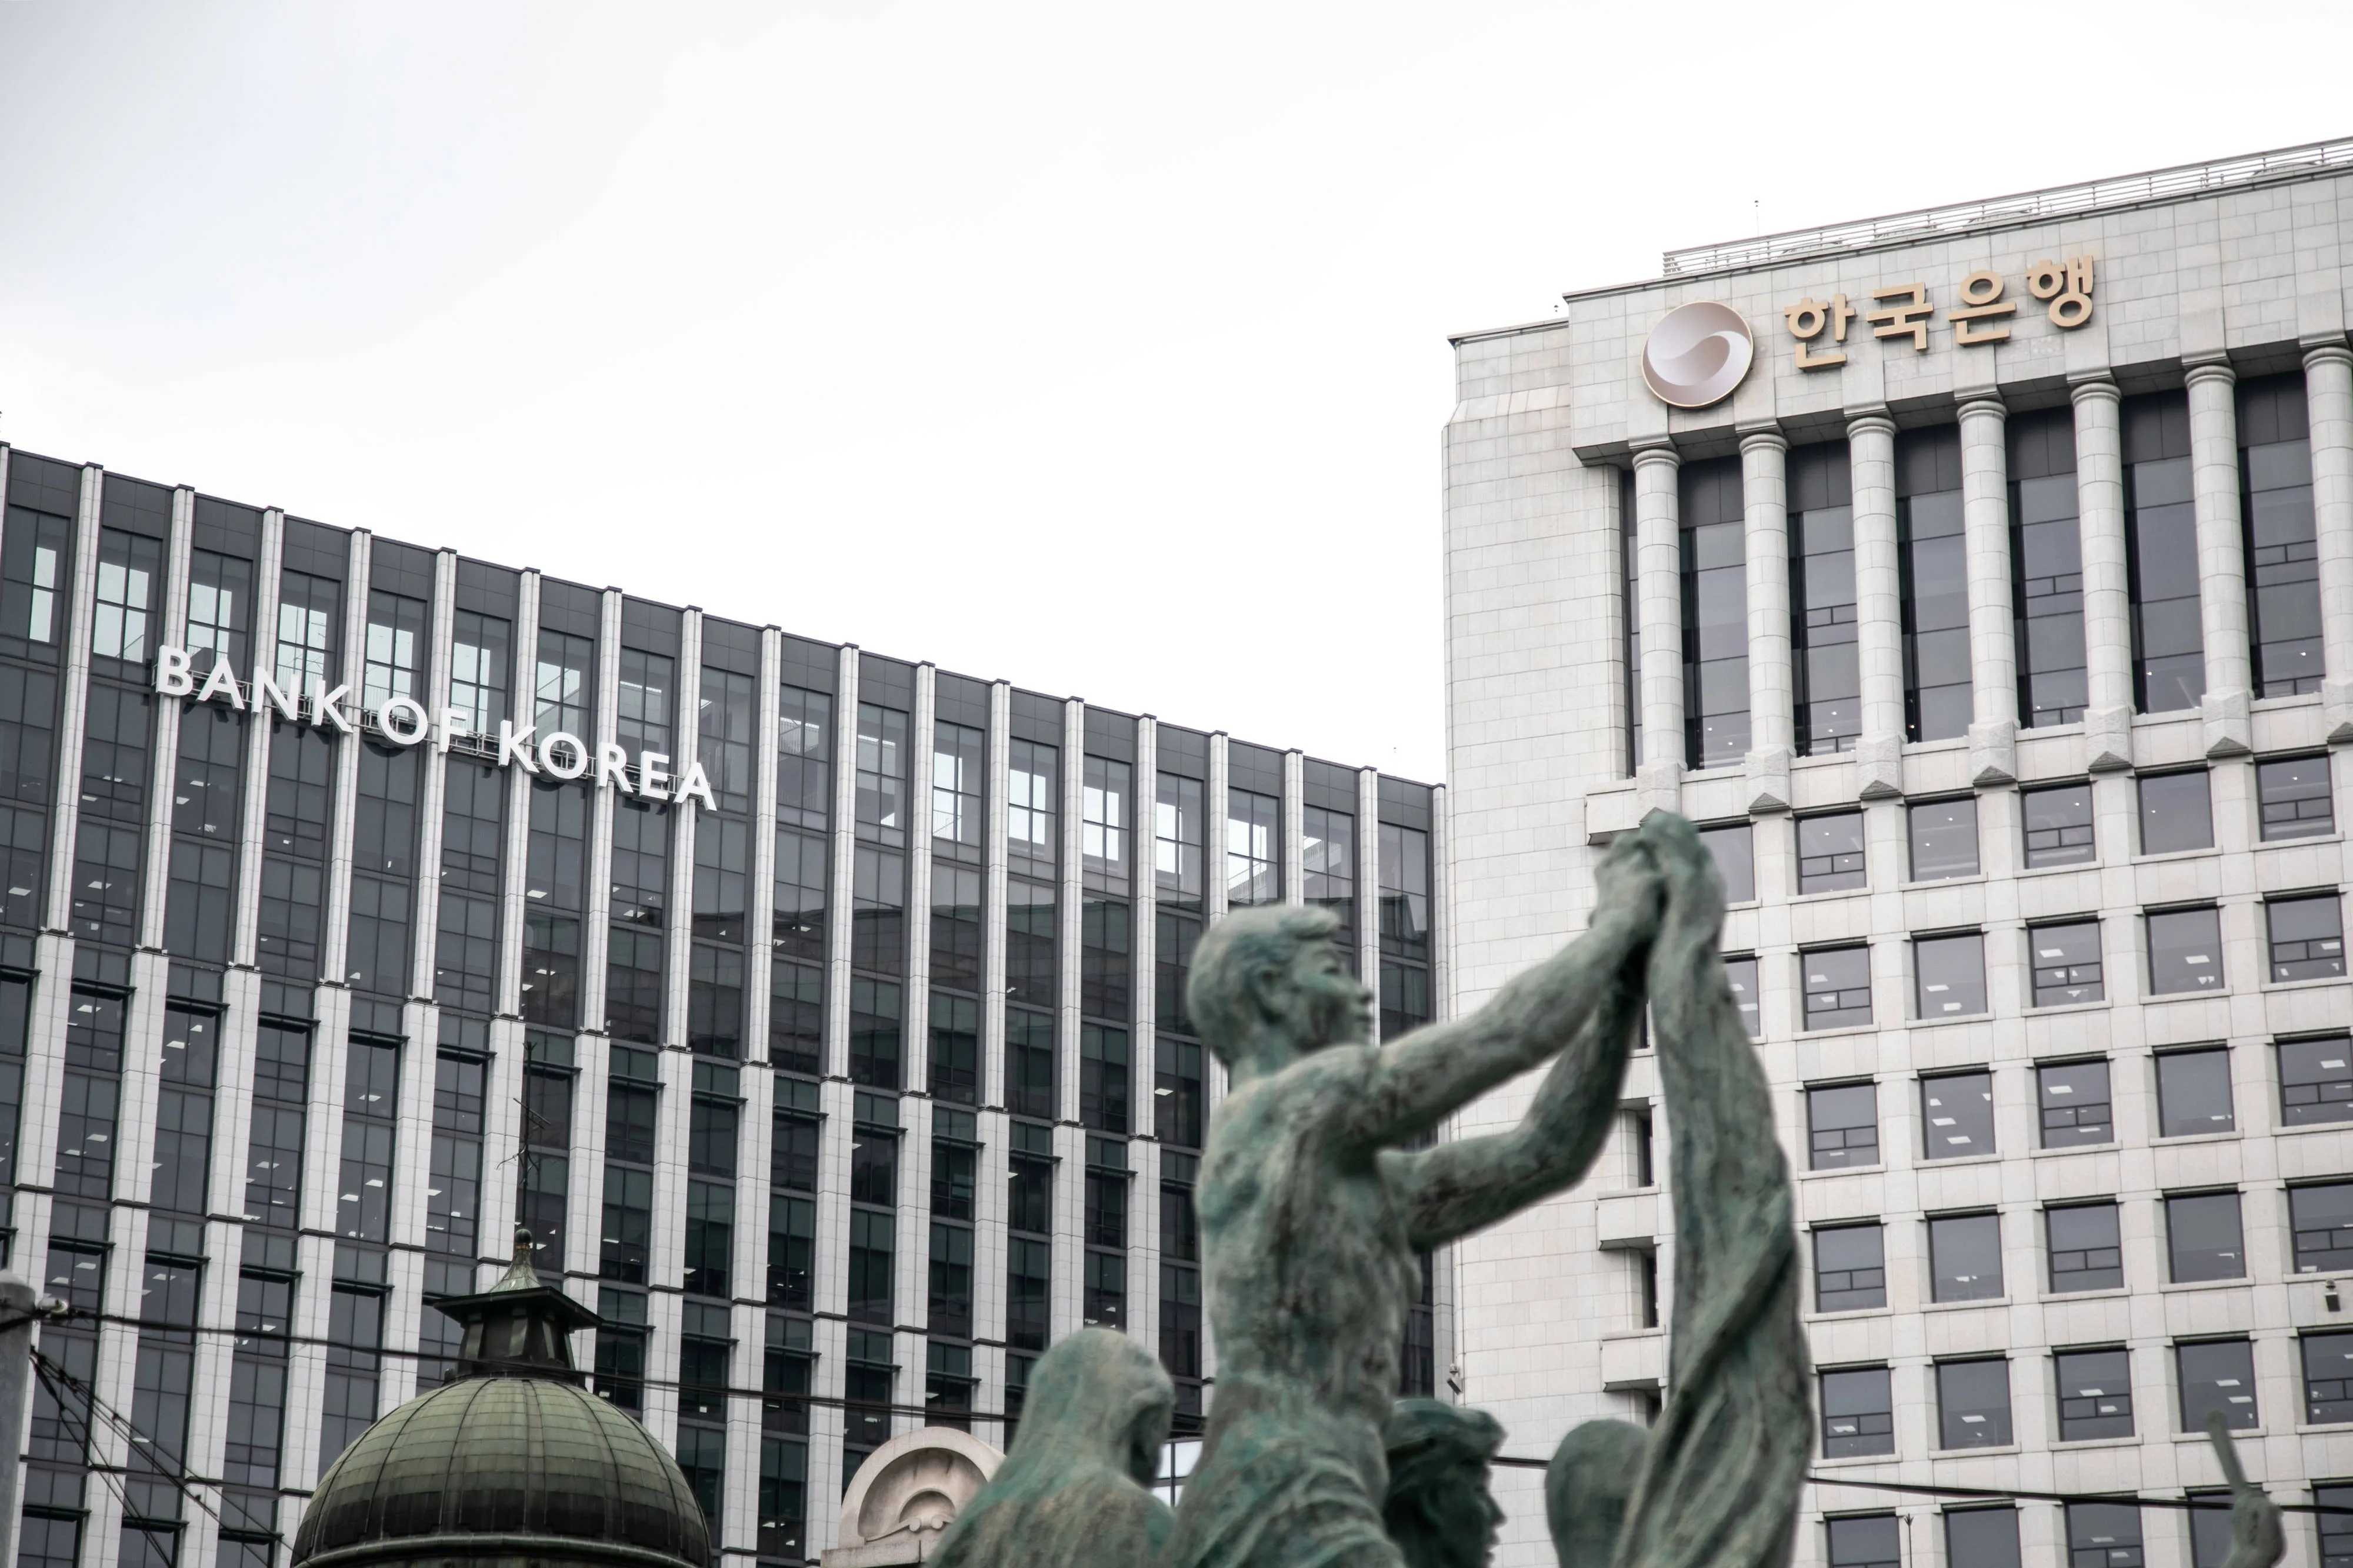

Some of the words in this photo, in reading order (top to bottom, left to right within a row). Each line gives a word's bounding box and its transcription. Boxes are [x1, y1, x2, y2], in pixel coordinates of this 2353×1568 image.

[1784, 255, 2095, 371] 한국은행
[156, 645, 353, 733] BANK
[377, 696, 467, 753] OF
[499, 719, 717, 811] KOREA
